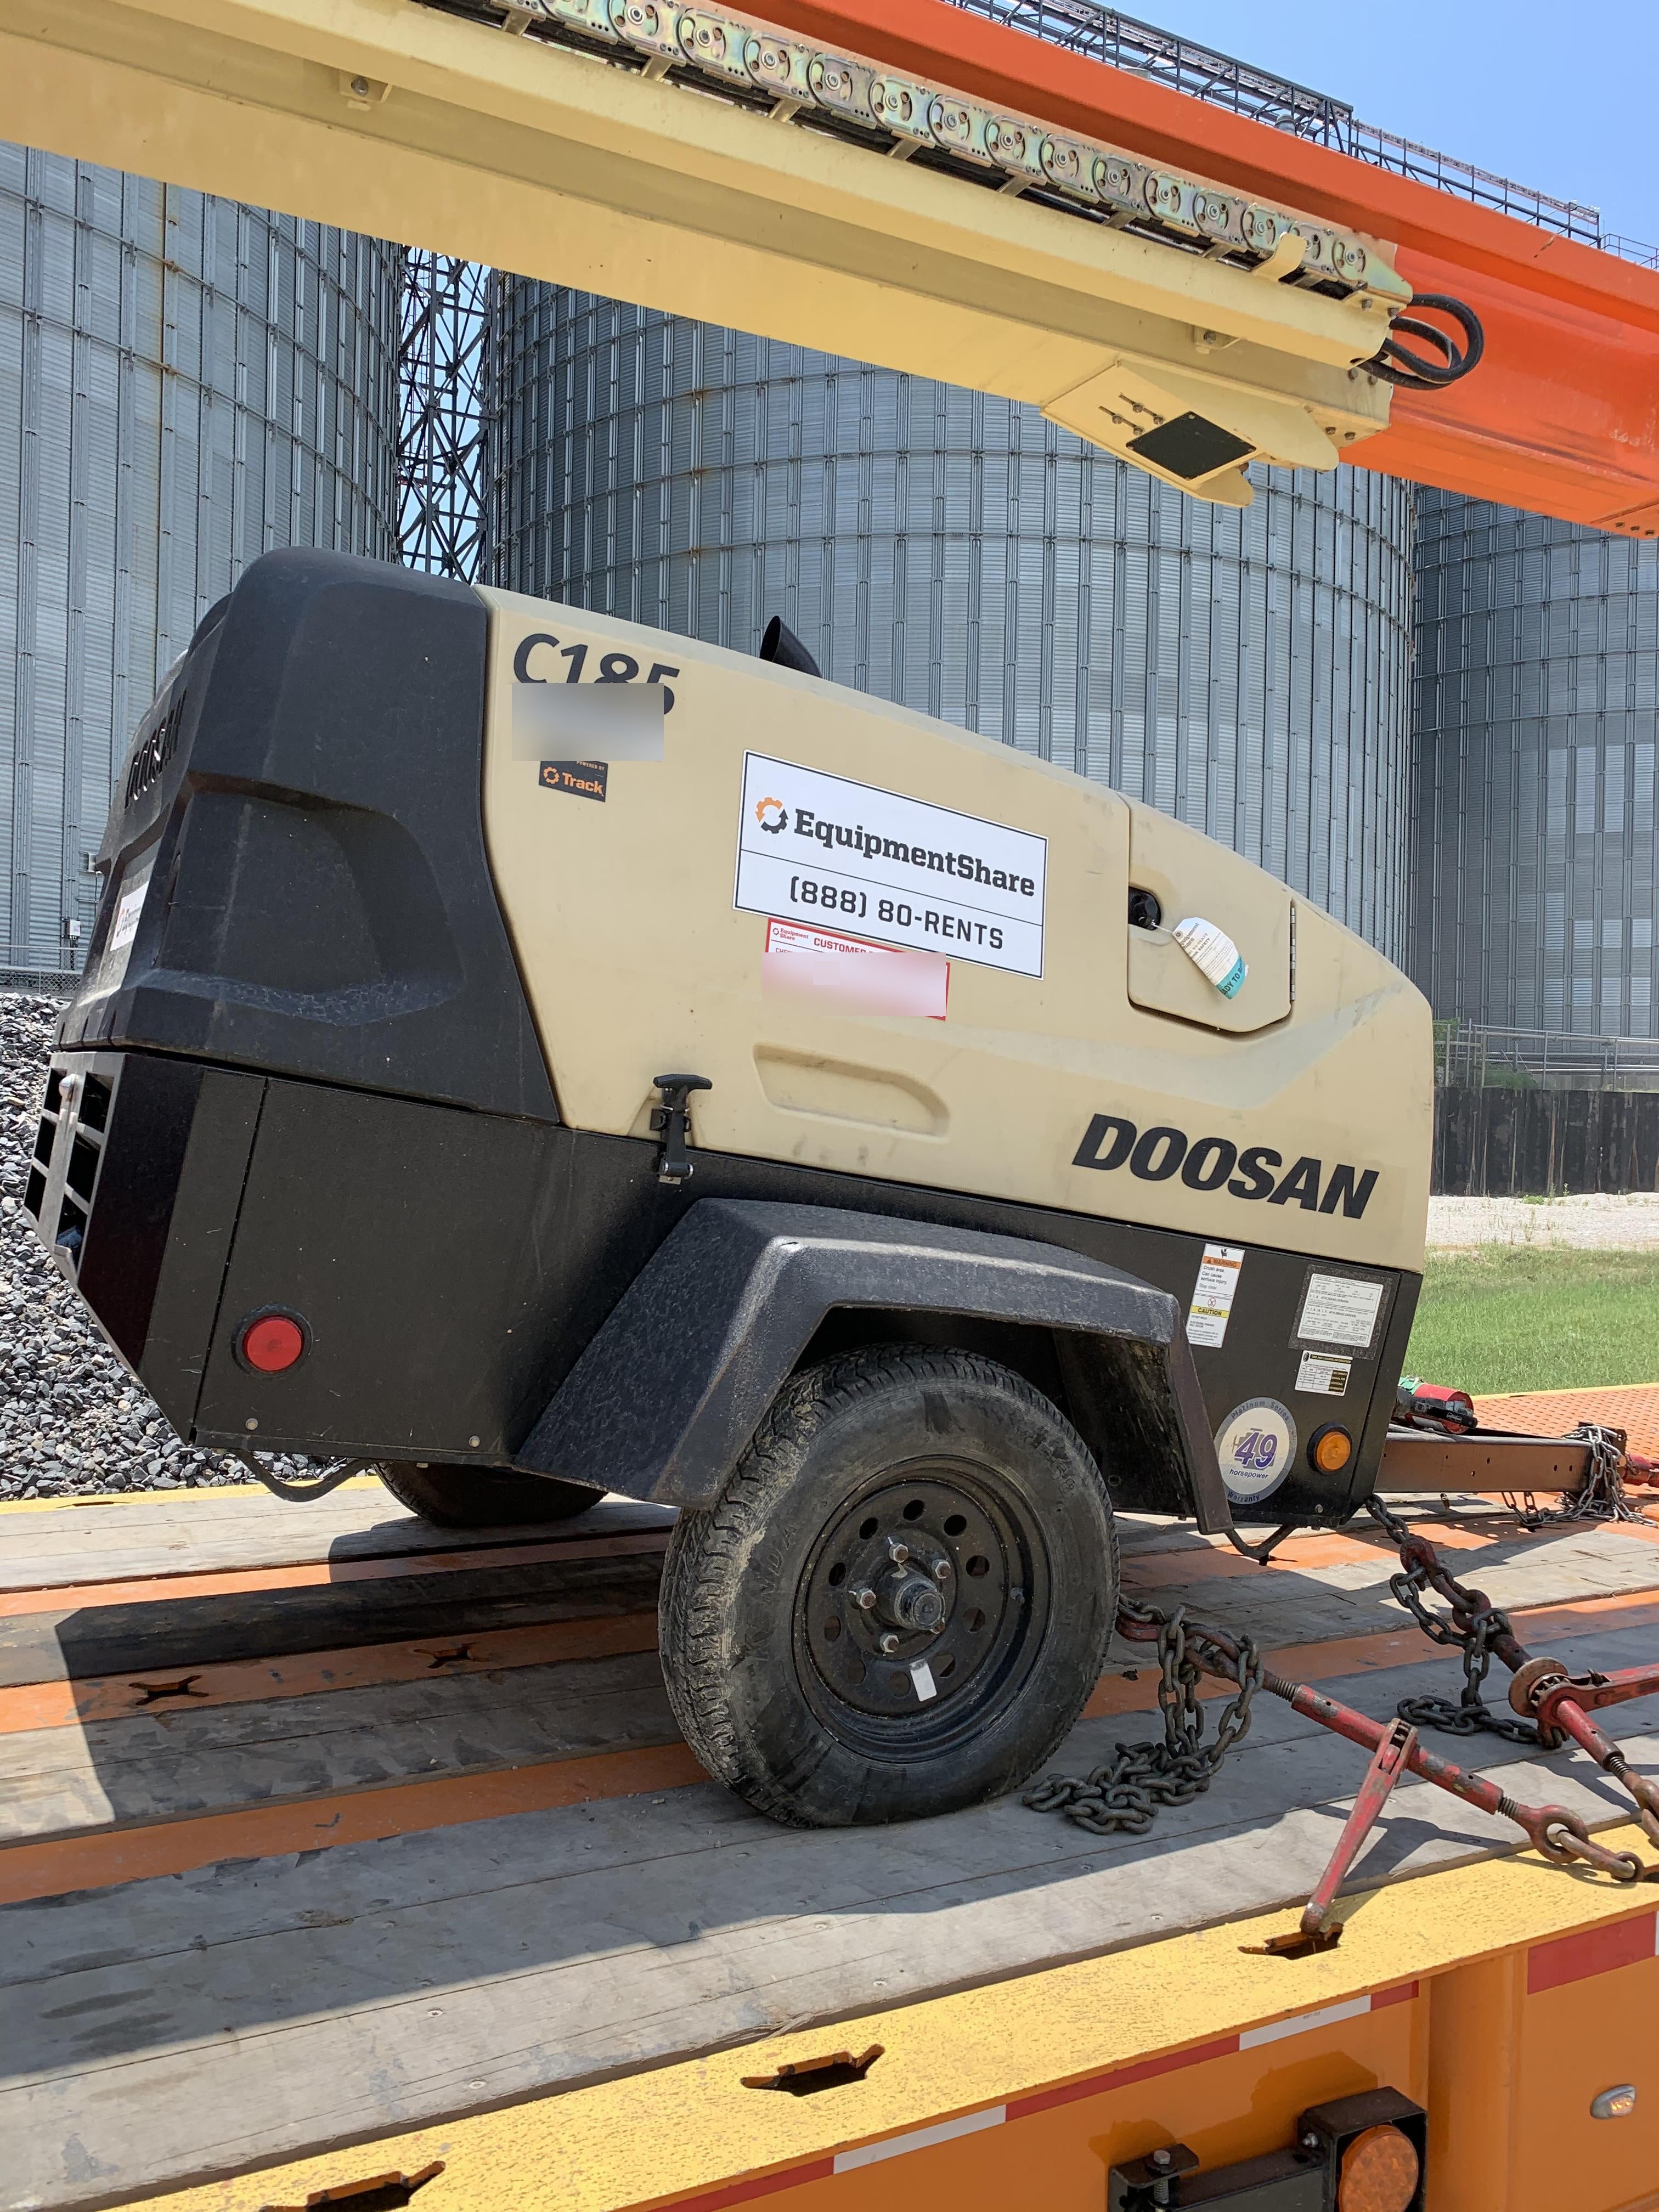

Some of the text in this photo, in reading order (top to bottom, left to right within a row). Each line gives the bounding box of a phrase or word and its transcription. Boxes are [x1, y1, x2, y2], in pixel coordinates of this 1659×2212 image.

[514, 634, 680, 715] C185
[562, 772, 603, 794] Track
[794, 808, 1035, 896] EquipmentShare
[790, 876, 1003, 950] (888) 80-RENTS
[780, 928, 809, 939] Equipment
[1231, 973, 1240, 982] TO
[1071, 1113, 1380, 1220] DOOSAN
[1213, 1259, 1237, 1268] WARNING
[1198, 1307, 1222, 1316] CAUTION
[1269, 1402, 1289, 1421] Series
[1234, 1431, 1278, 1469] 49
[1229, 1469, 1269, 1480] horsepower
[1228, 1491, 1261, 1502] Warranty
